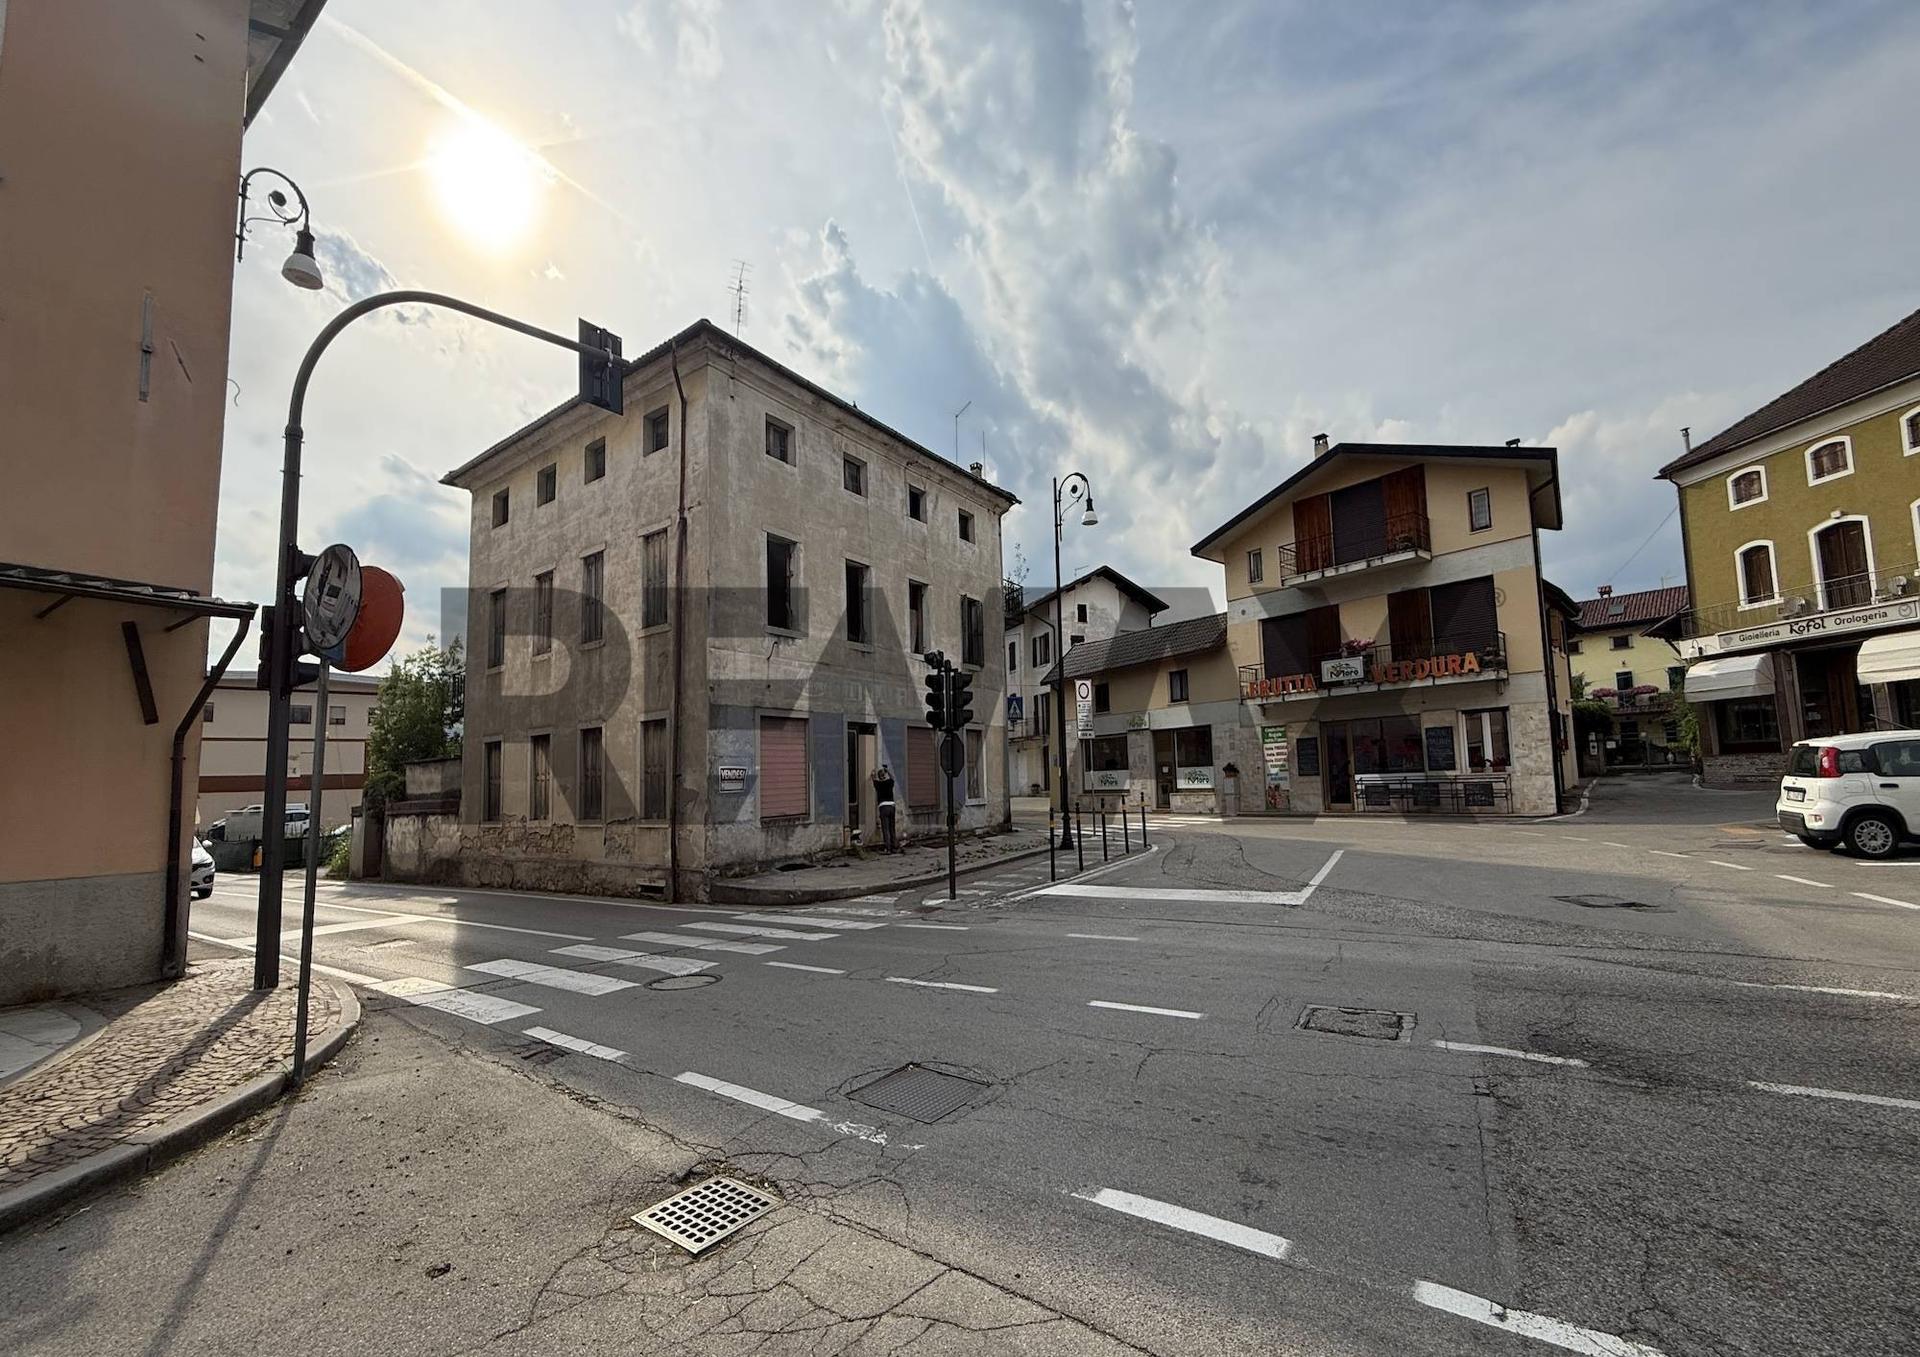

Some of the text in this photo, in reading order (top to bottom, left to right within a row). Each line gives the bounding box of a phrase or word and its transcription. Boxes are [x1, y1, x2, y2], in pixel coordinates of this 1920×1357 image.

[1738, 628, 1781, 642] Gioielleria
[1834, 610, 1888, 626] Orologeria
[1248, 652, 1480, 698] FRUTTA VERDURA
[1329, 668, 1359, 679] Moro
